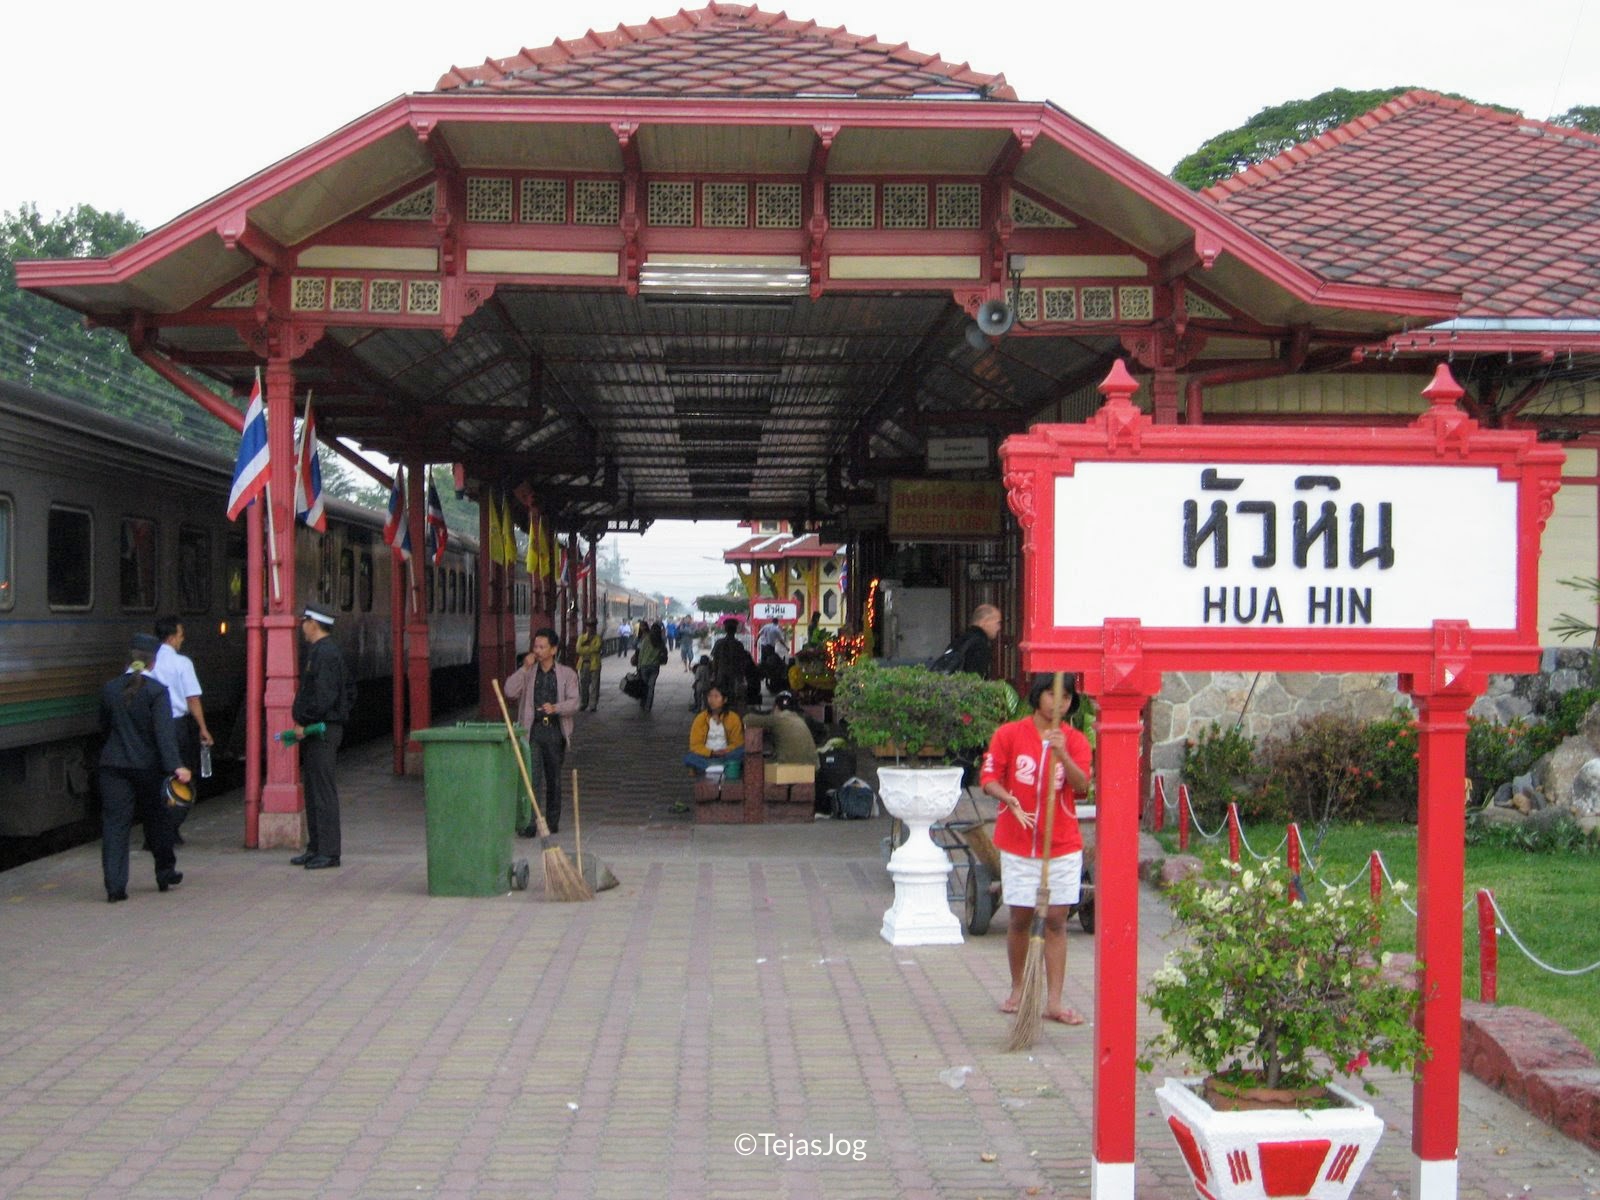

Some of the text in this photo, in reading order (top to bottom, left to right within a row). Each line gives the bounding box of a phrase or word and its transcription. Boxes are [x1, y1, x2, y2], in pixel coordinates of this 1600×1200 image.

[1182, 468, 1395, 570] หัวหิน
[1203, 586, 1372, 624] HUA HIN
[1015, 754, 1036, 786] 2
